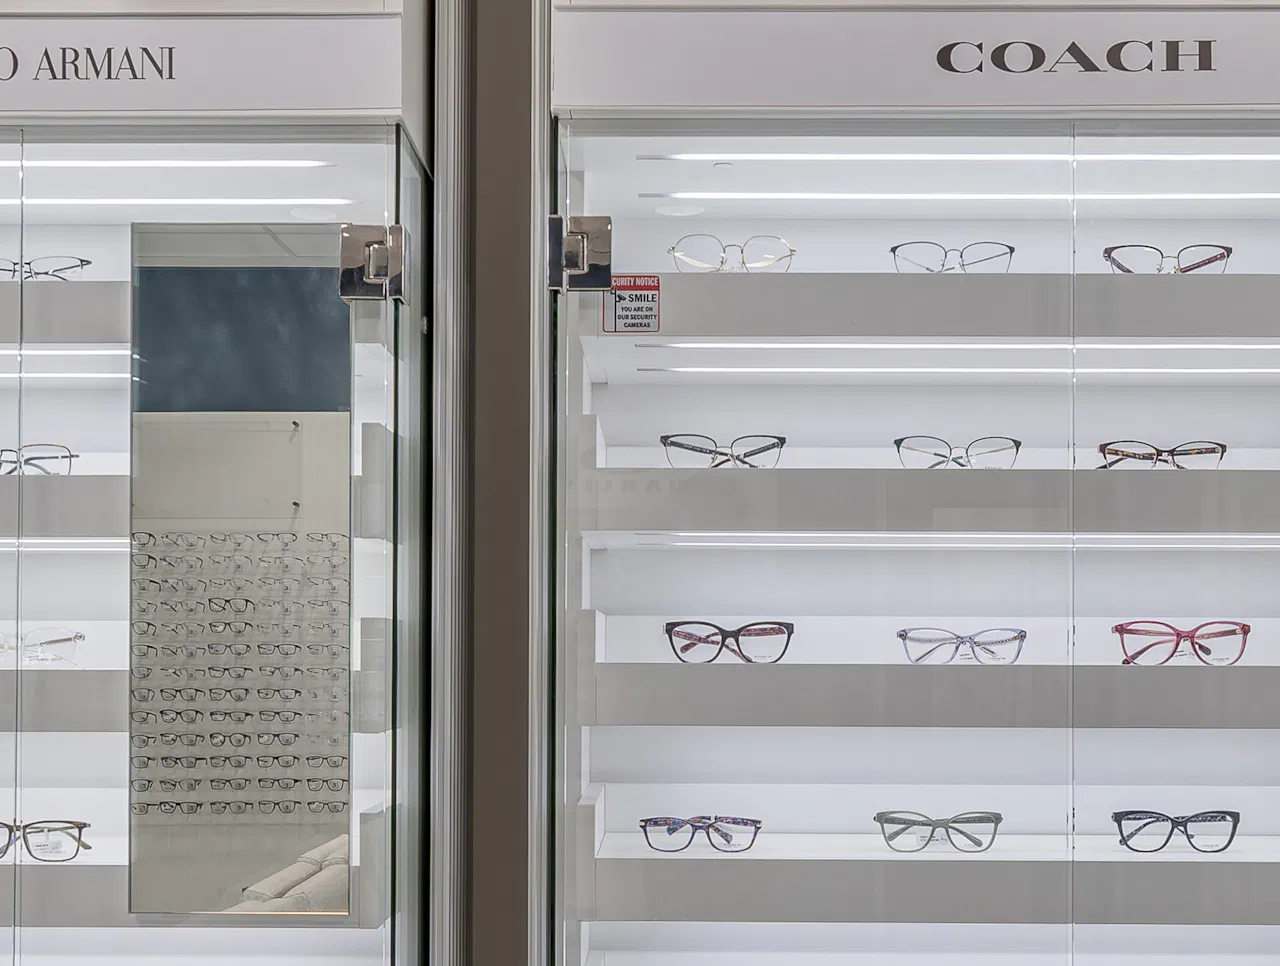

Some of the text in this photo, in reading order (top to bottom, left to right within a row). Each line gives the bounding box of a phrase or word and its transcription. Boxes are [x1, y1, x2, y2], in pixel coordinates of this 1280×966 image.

[32, 46, 176, 81] ARMANI
[936, 40, 1217, 74] COACH
[612, 277, 658, 286] CURITY NOTICE
[628, 293, 657, 303] SMILE
